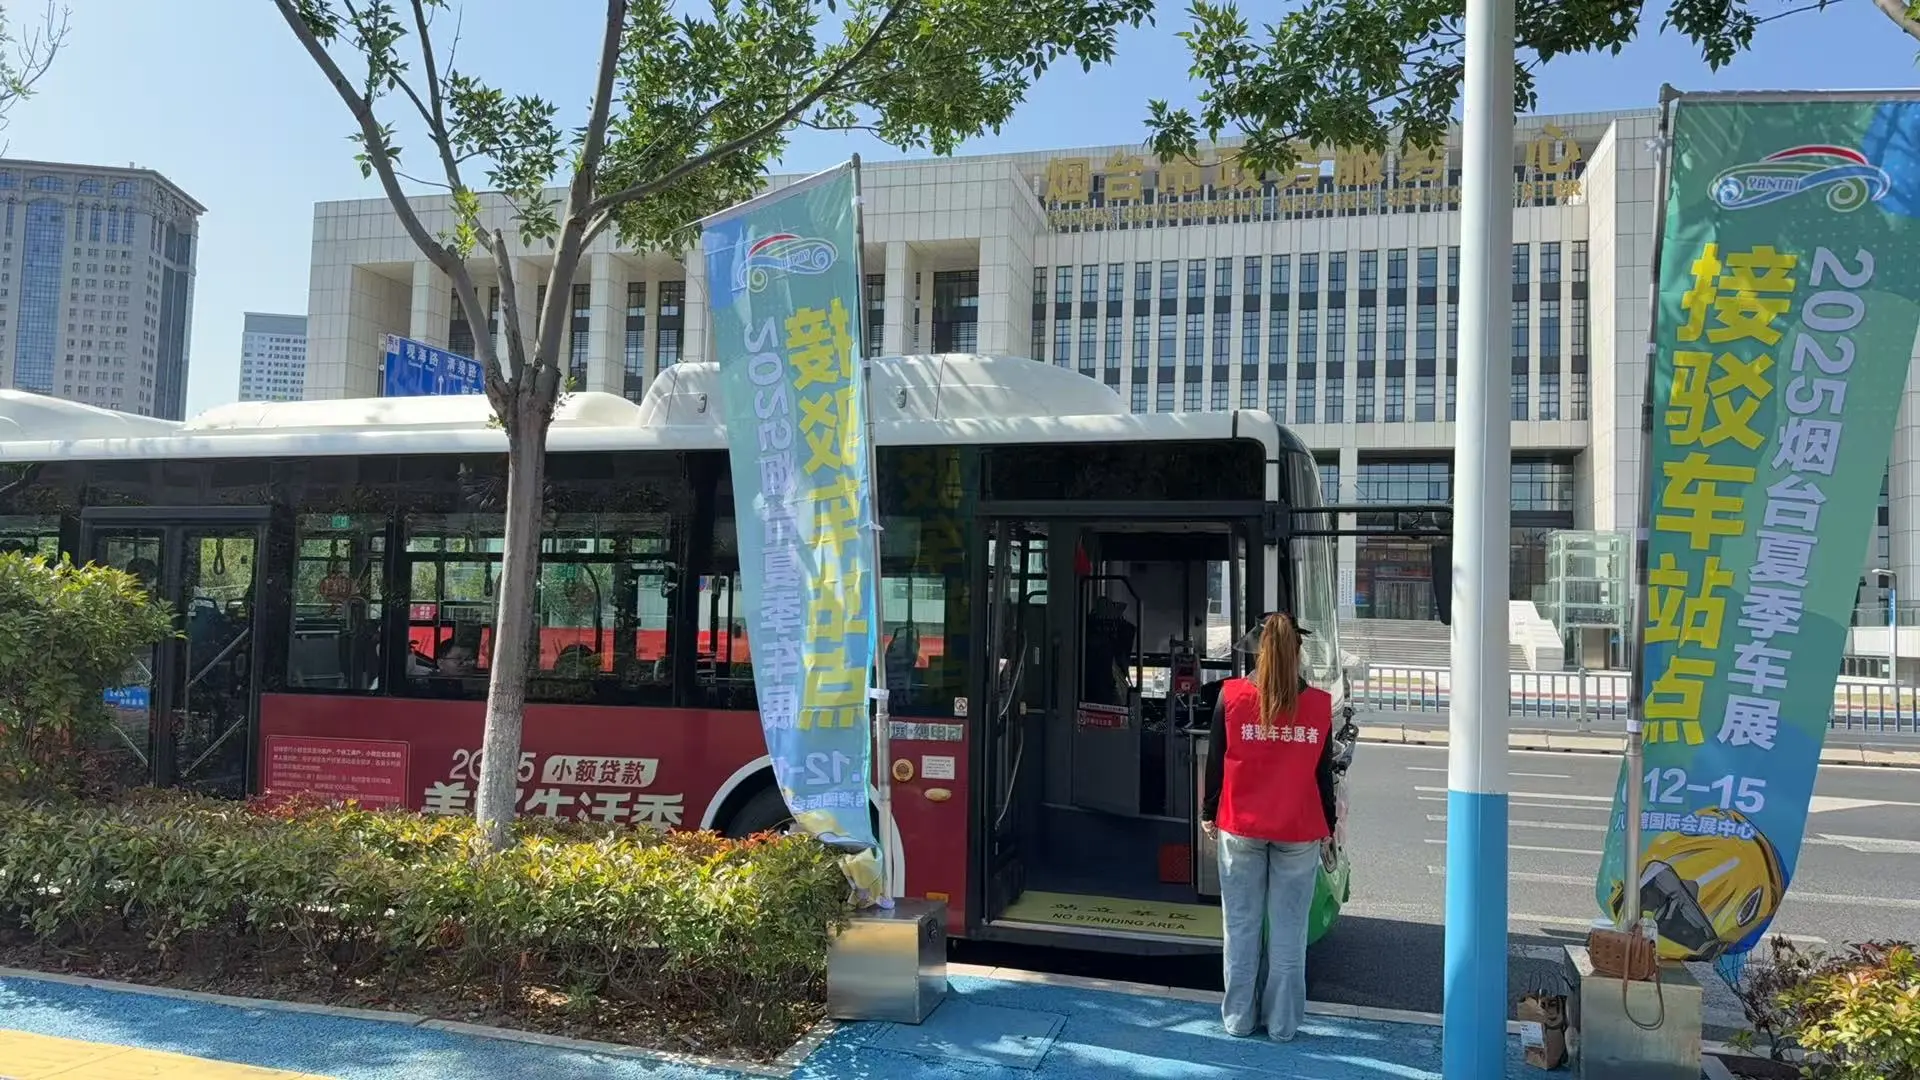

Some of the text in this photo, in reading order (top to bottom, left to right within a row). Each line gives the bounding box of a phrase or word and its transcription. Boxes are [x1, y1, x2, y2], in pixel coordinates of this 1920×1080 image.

[1044, 123, 1581, 201] 烟台市政务服务心
[1385, 185, 1463, 207] SERVIC
[1747, 175, 1800, 192] YANTAI
[406, 343, 439, 367] 观海路
[447, 356, 478, 379] 清泉路
[1641, 242, 1798, 746] 接驳车站点
[1717, 246, 1875, 750] 2025烟台夏季车展
[1241, 723, 1319, 744] 接驳车志愿者
[552, 758, 645, 784] 小额贷款
[1622, 767, 1767, 813] 12-15
[1614, 811, 1756, 839] 八湾国际会展中心
[1052, 912, 1186, 930] NO STANDING AREA
